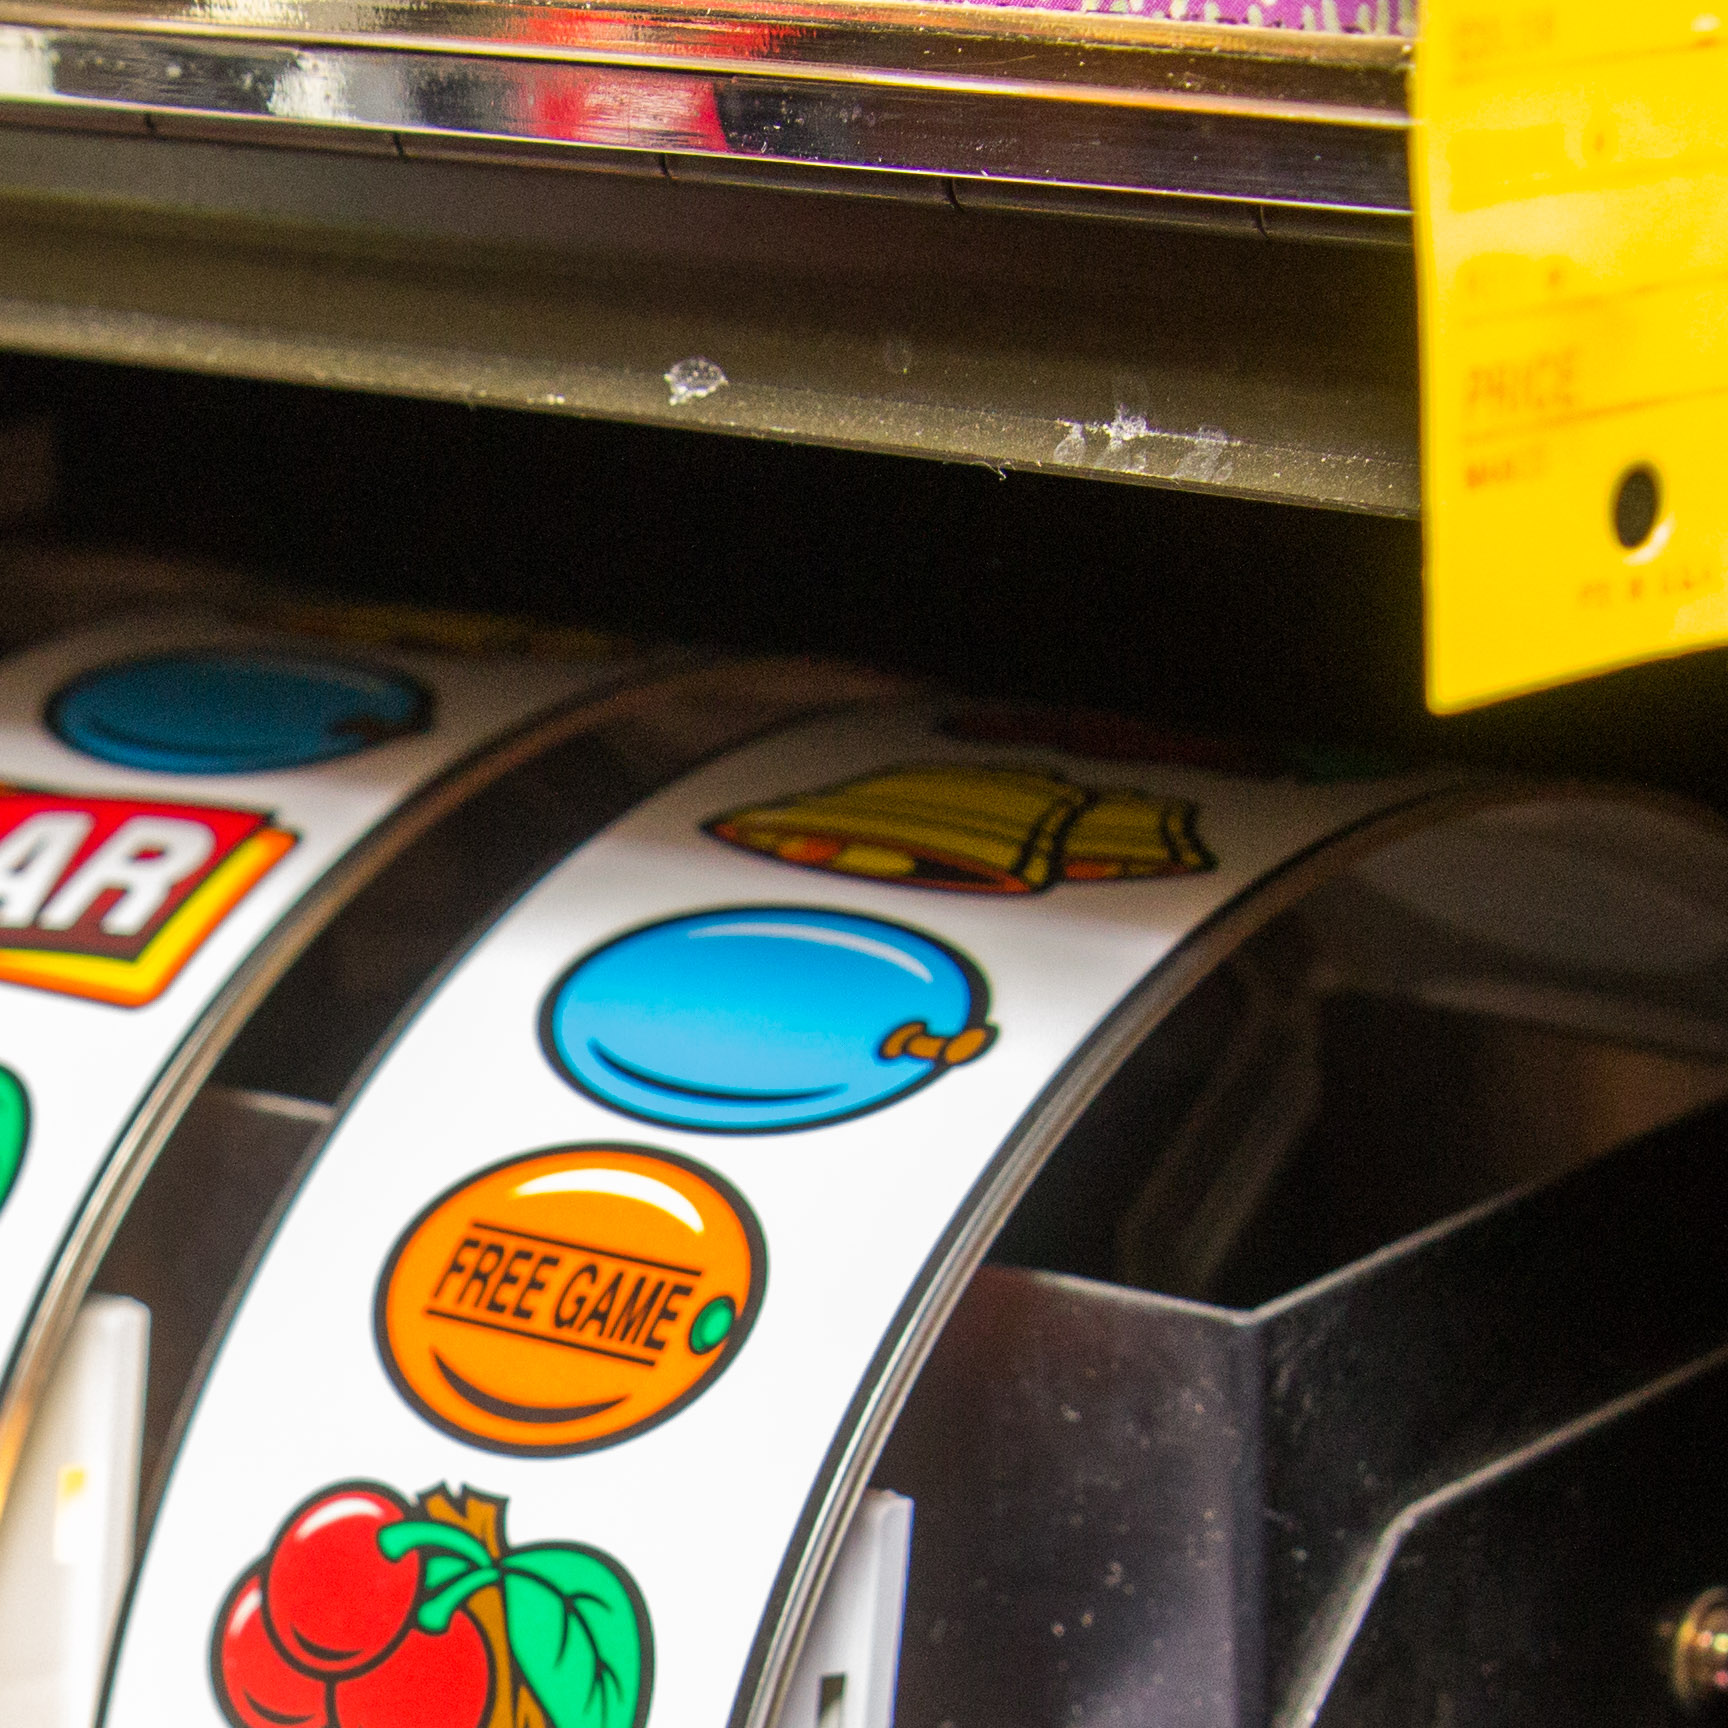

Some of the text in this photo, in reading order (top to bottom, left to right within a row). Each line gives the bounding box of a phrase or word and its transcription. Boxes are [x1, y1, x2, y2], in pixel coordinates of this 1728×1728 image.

[1463, 346, 1580, 414] PRICE
[432, 1237, 694, 1351] FREE GAME
